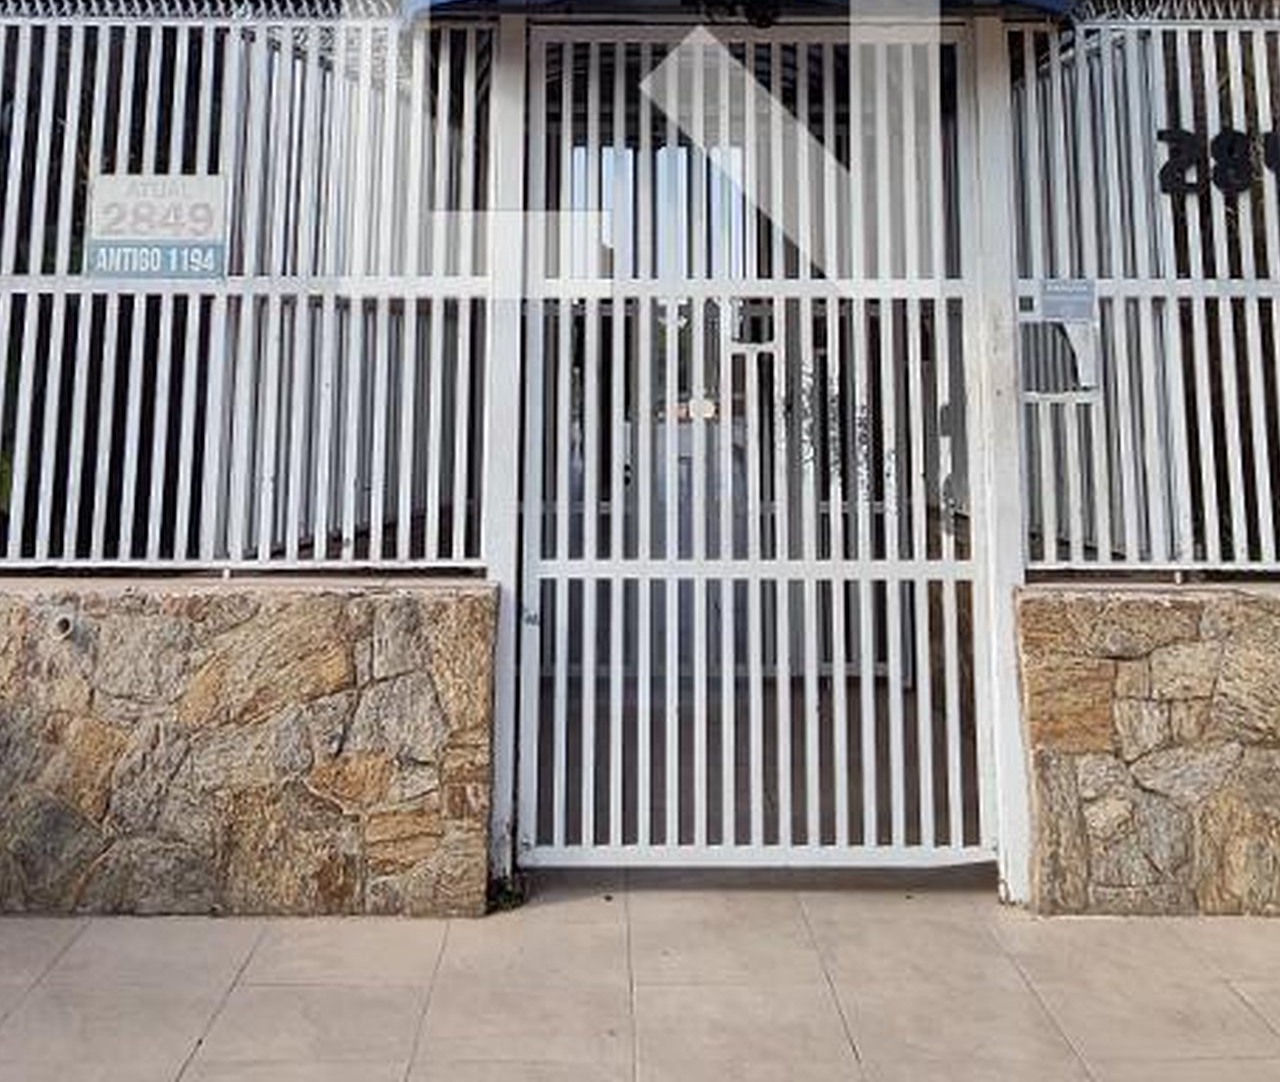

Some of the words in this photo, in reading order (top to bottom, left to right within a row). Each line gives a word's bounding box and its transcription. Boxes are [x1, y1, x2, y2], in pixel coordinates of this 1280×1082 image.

[100, 201, 215, 237] 2849
[96, 246, 161, 272] ANTIGO
[168, 246, 215, 272] 1194
